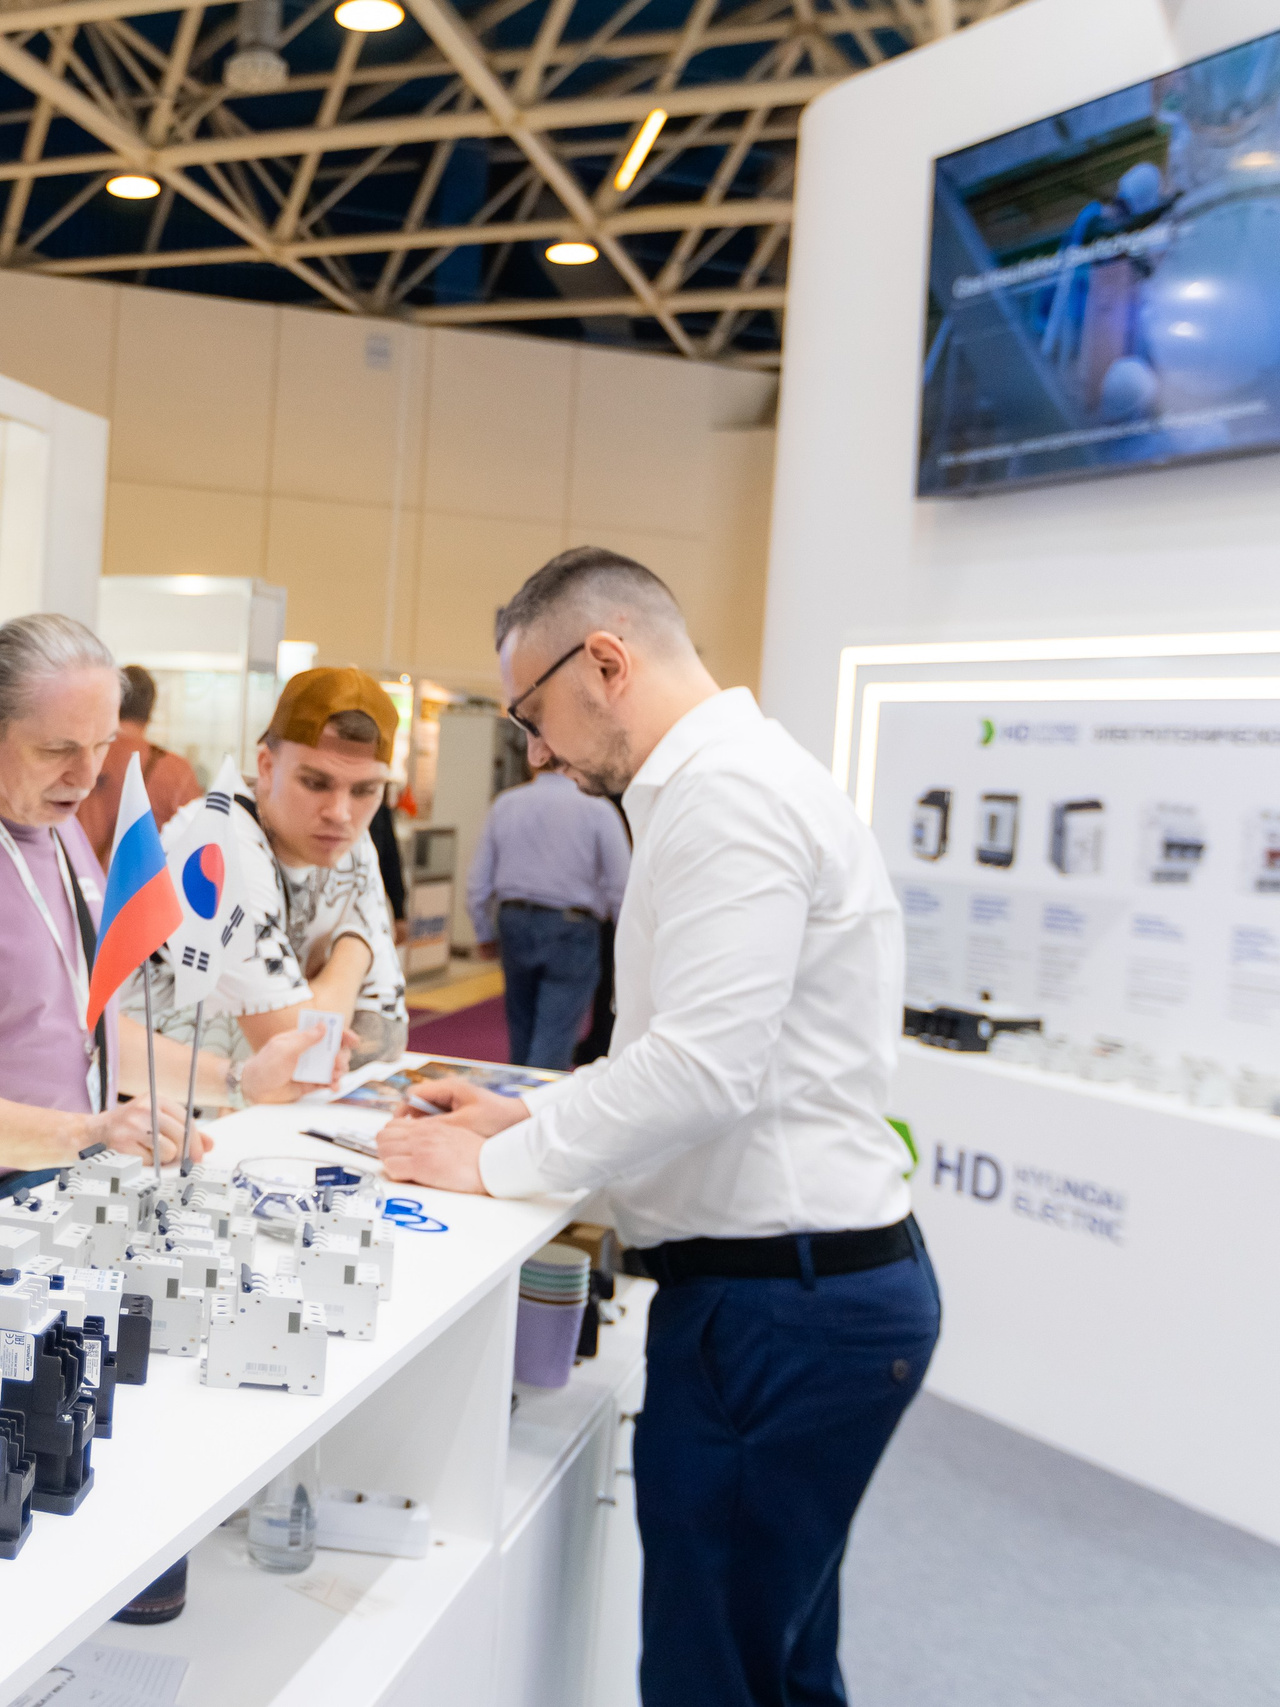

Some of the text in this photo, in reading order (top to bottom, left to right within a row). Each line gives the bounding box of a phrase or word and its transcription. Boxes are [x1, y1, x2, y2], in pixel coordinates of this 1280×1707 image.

[933, 1142, 1004, 1202] HD
[5, 1333, 14, 1345] CE
[15, 1334, 25, 1345] EAC
